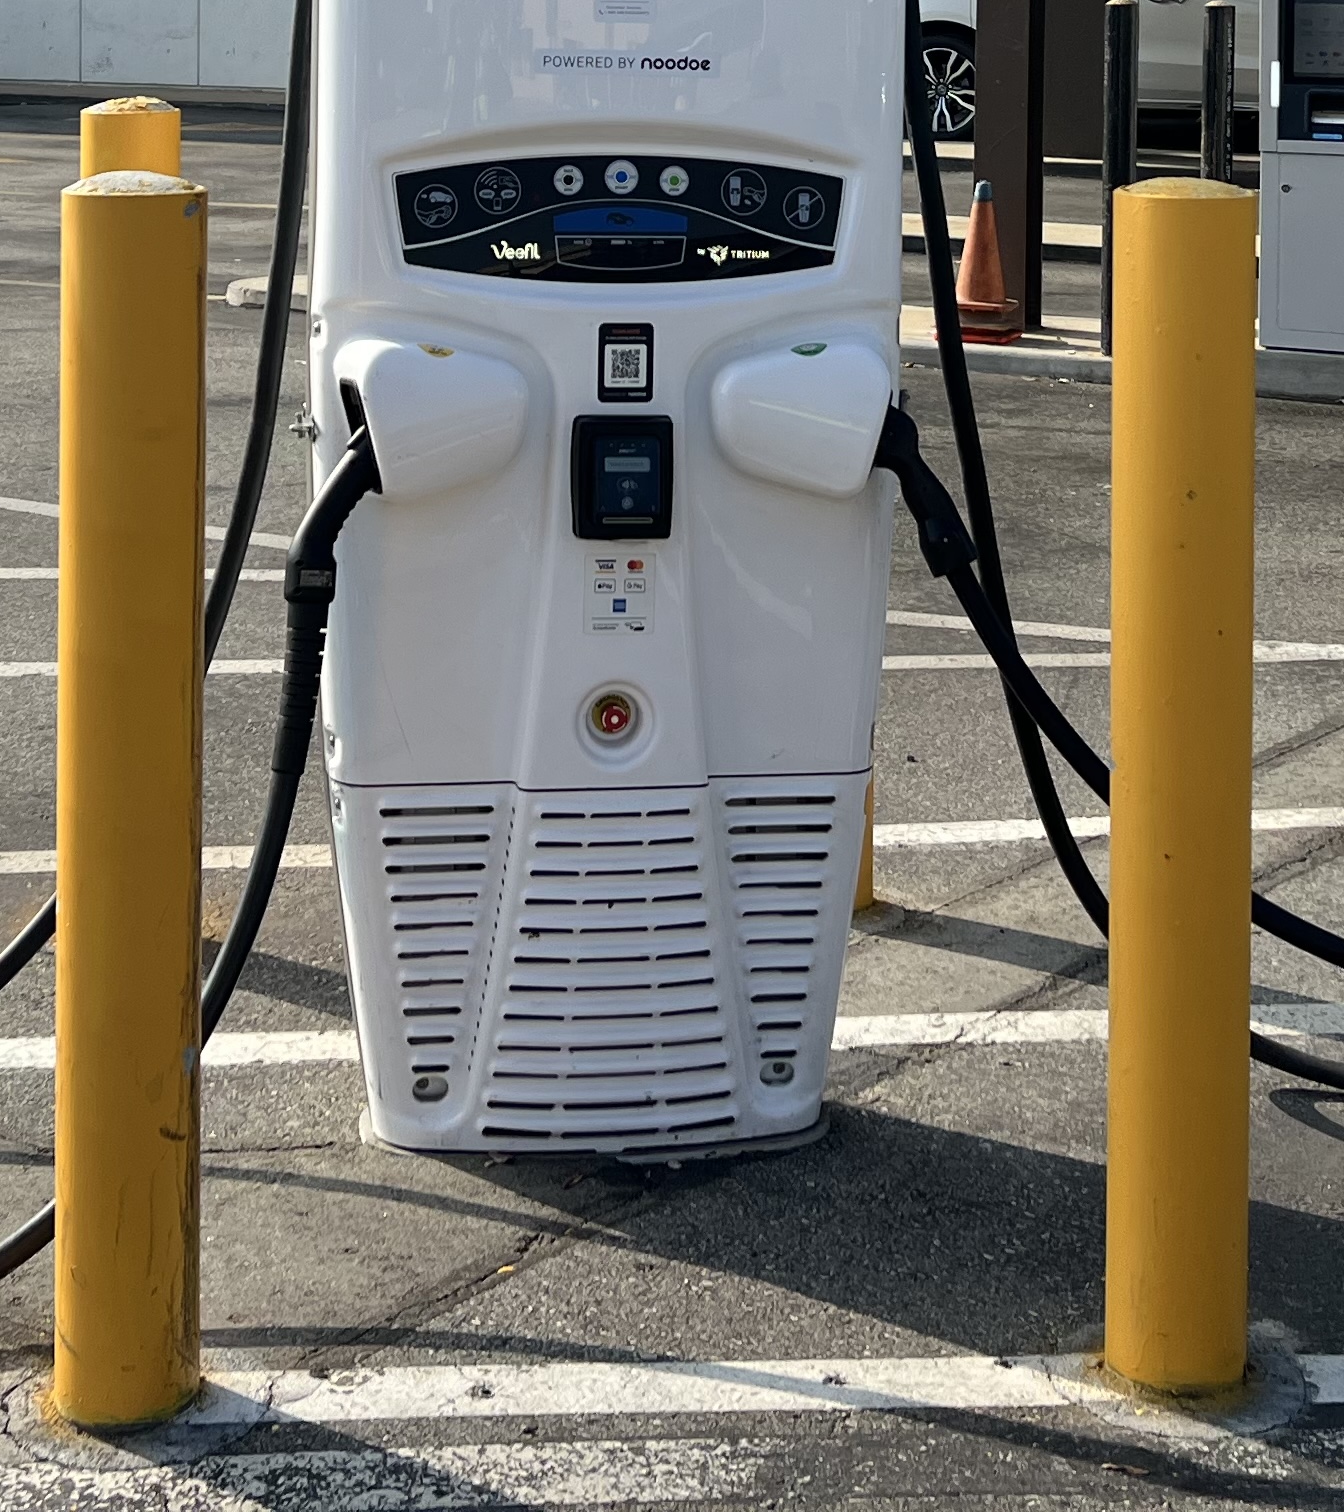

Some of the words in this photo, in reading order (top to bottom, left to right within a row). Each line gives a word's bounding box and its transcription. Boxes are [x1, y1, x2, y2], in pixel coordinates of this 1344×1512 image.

[543, 55, 613, 69] POWERED
[618, 57, 636, 70] BY
[640, 55, 711, 71] noodoe
[490, 240, 541, 260] Veefil
[730, 250, 770, 259] TRITIUM
[598, 562, 614, 570] VISA
